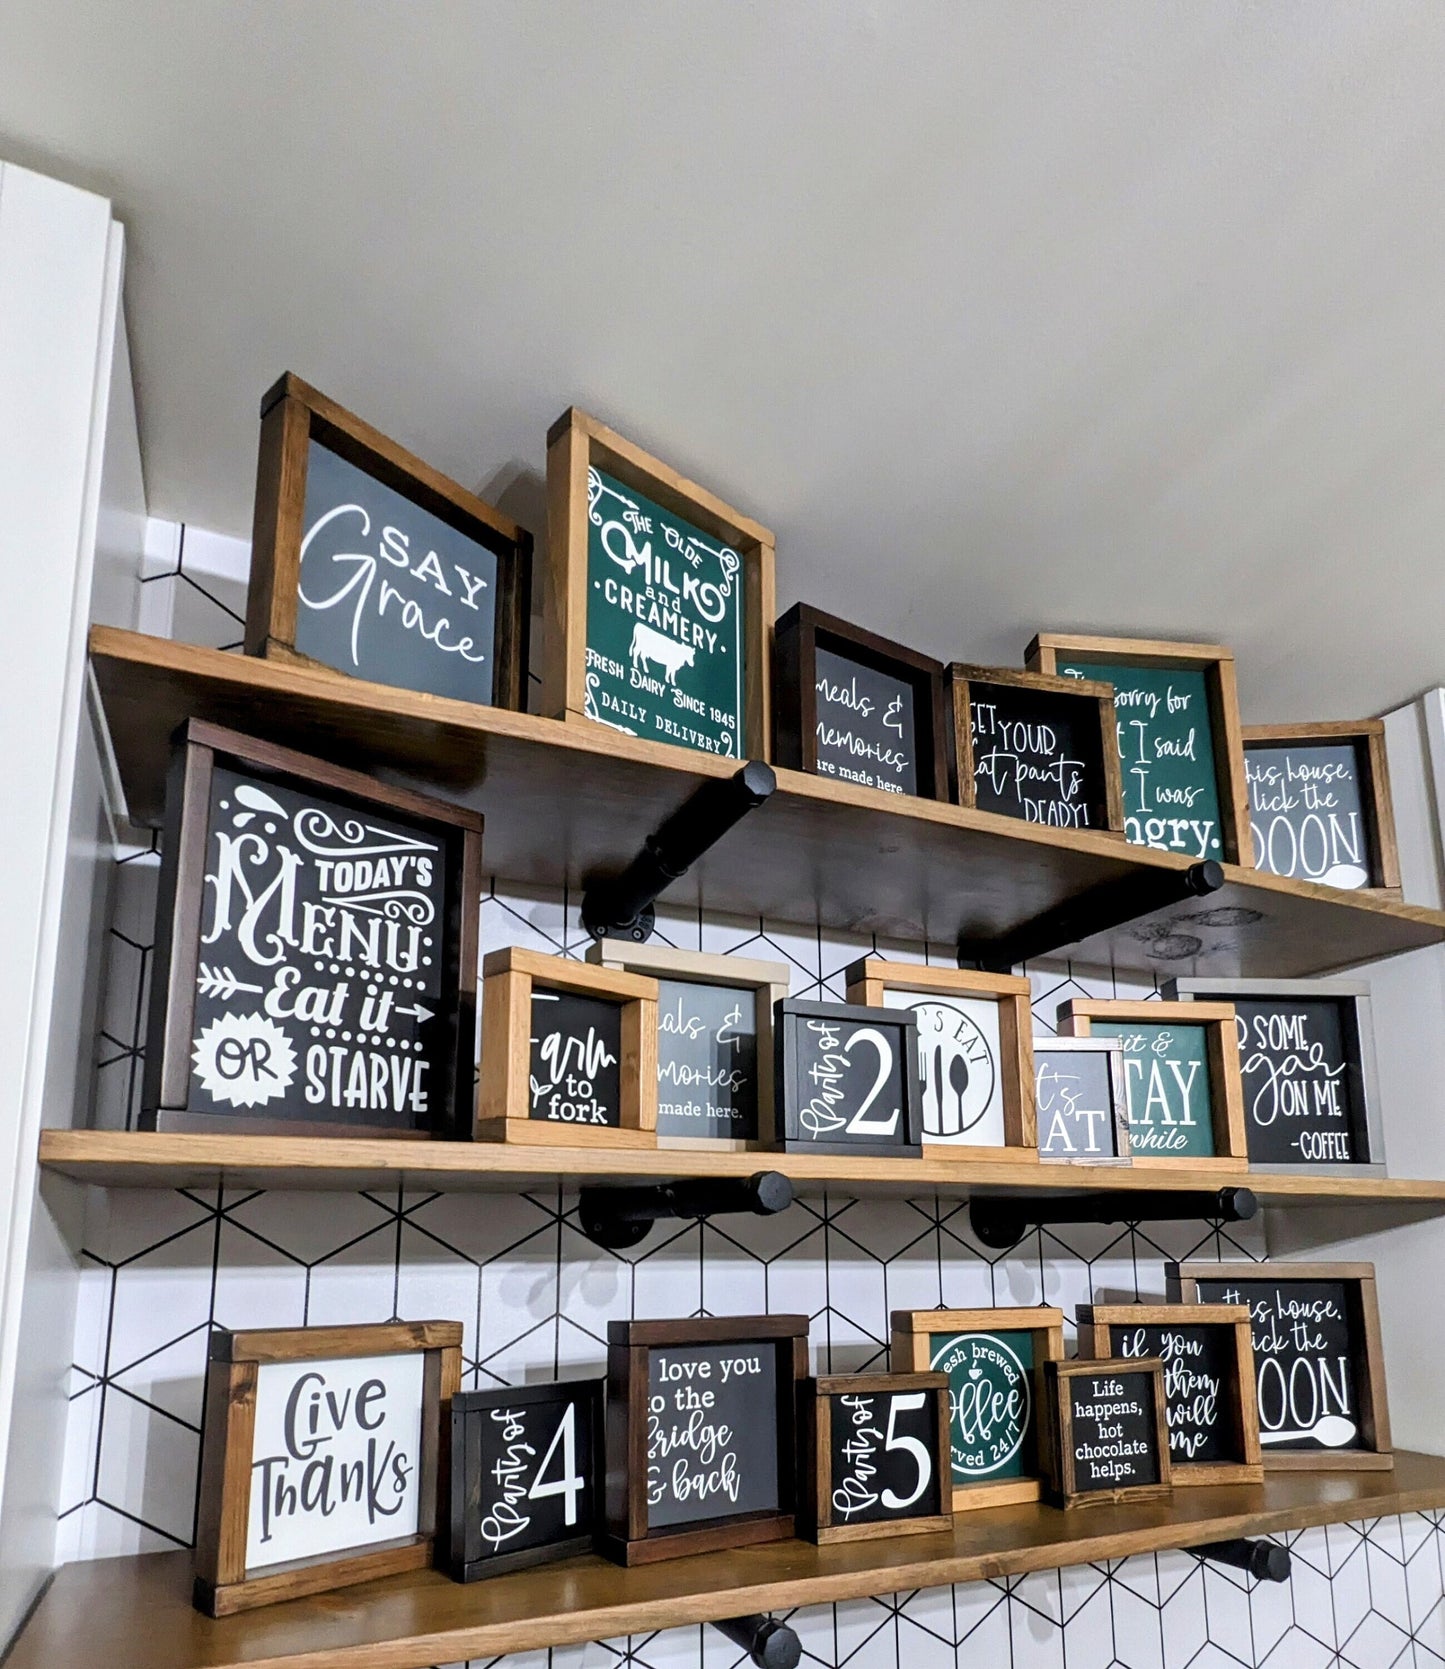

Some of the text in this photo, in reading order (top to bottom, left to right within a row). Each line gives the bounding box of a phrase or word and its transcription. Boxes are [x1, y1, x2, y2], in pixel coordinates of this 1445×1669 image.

[623, 509, 703, 569] THE OLDE
[298, 503, 485, 666] Grace
[379, 526, 488, 610] SAY
[601, 520, 726, 623] MILK
[605, 578, 717, 654] CREAMERY
[645, 585, 682, 614] and
[586, 647, 736, 730] FRESH DAIRY SINCE 1945
[1167, 685, 1192, 714] for
[601, 691, 721, 754] DAILY DELIVERY
[882, 694, 903, 739] &
[997, 720, 1056, 756] YOUR
[1129, 720, 1152, 764] I
[1154, 727, 1197, 762] said
[838, 766, 874, 786] made
[972, 740, 1086, 803] at pants
[1130, 768, 1205, 813] I was
[1244, 756, 1353, 785] his house.
[1253, 778, 1339, 813] lick the
[1124, 816, 1221, 859] ngry.
[1251, 812, 1363, 877] OON
[314, 856, 433, 892] TODAY'S
[201, 832, 424, 974] MENU
[264, 966, 394, 1033] Eat it
[658, 997, 742, 1053] als &
[952, 1019, 990, 1066] EAT
[1123, 1031, 1174, 1058] it &
[1253, 1014, 1309, 1051] SOME
[215, 1037, 279, 1082] OR
[305, 1044, 430, 1112] STARVE
[657, 1060, 748, 1093] mories
[800, 1020, 851, 1140] Party of
[565, 1073, 593, 1098] to
[844, 1028, 900, 1136] 2
[1035, 1062, 1084, 1116] t's
[1124, 1058, 1201, 1126] TAY
[1239, 1042, 1346, 1126] gar
[1281, 1079, 1343, 1117] ON ME
[548, 1094, 608, 1125] fork
[658, 1101, 743, 1119] made here.
[1040, 1109, 1105, 1152] AT
[1290, 1131, 1350, 1160] -COFFEE
[1277, 1289, 1342, 1320] house.
[1159, 1332, 1203, 1362] you
[1251, 1315, 1328, 1354] ick the
[659, 1356, 762, 1383] love you
[943, 1342, 1020, 1386] esh brewed
[1164, 1357, 1219, 1398] them
[674, 1386, 715, 1411] the
[1092, 1380, 1124, 1397] Life
[1258, 1356, 1350, 1430] OON
[283, 1371, 386, 1461] Give
[1075, 1401, 1143, 1424] happens,
[1098, 1422, 1124, 1439] hot
[1166, 1395, 1218, 1427] will
[528, 1401, 585, 1526] 4
[832, 1394, 884, 1521] Party of
[881, 1392, 932, 1509] 5
[950, 1421, 1020, 1466] rved 24/7
[1075, 1440, 1148, 1460] chocolate
[1169, 1431, 1208, 1458] me
[251, 1437, 413, 1543] Thanks
[481, 1408, 537, 1552] Party of
[672, 1452, 741, 1503] back
[1090, 1461, 1136, 1481] helps.
